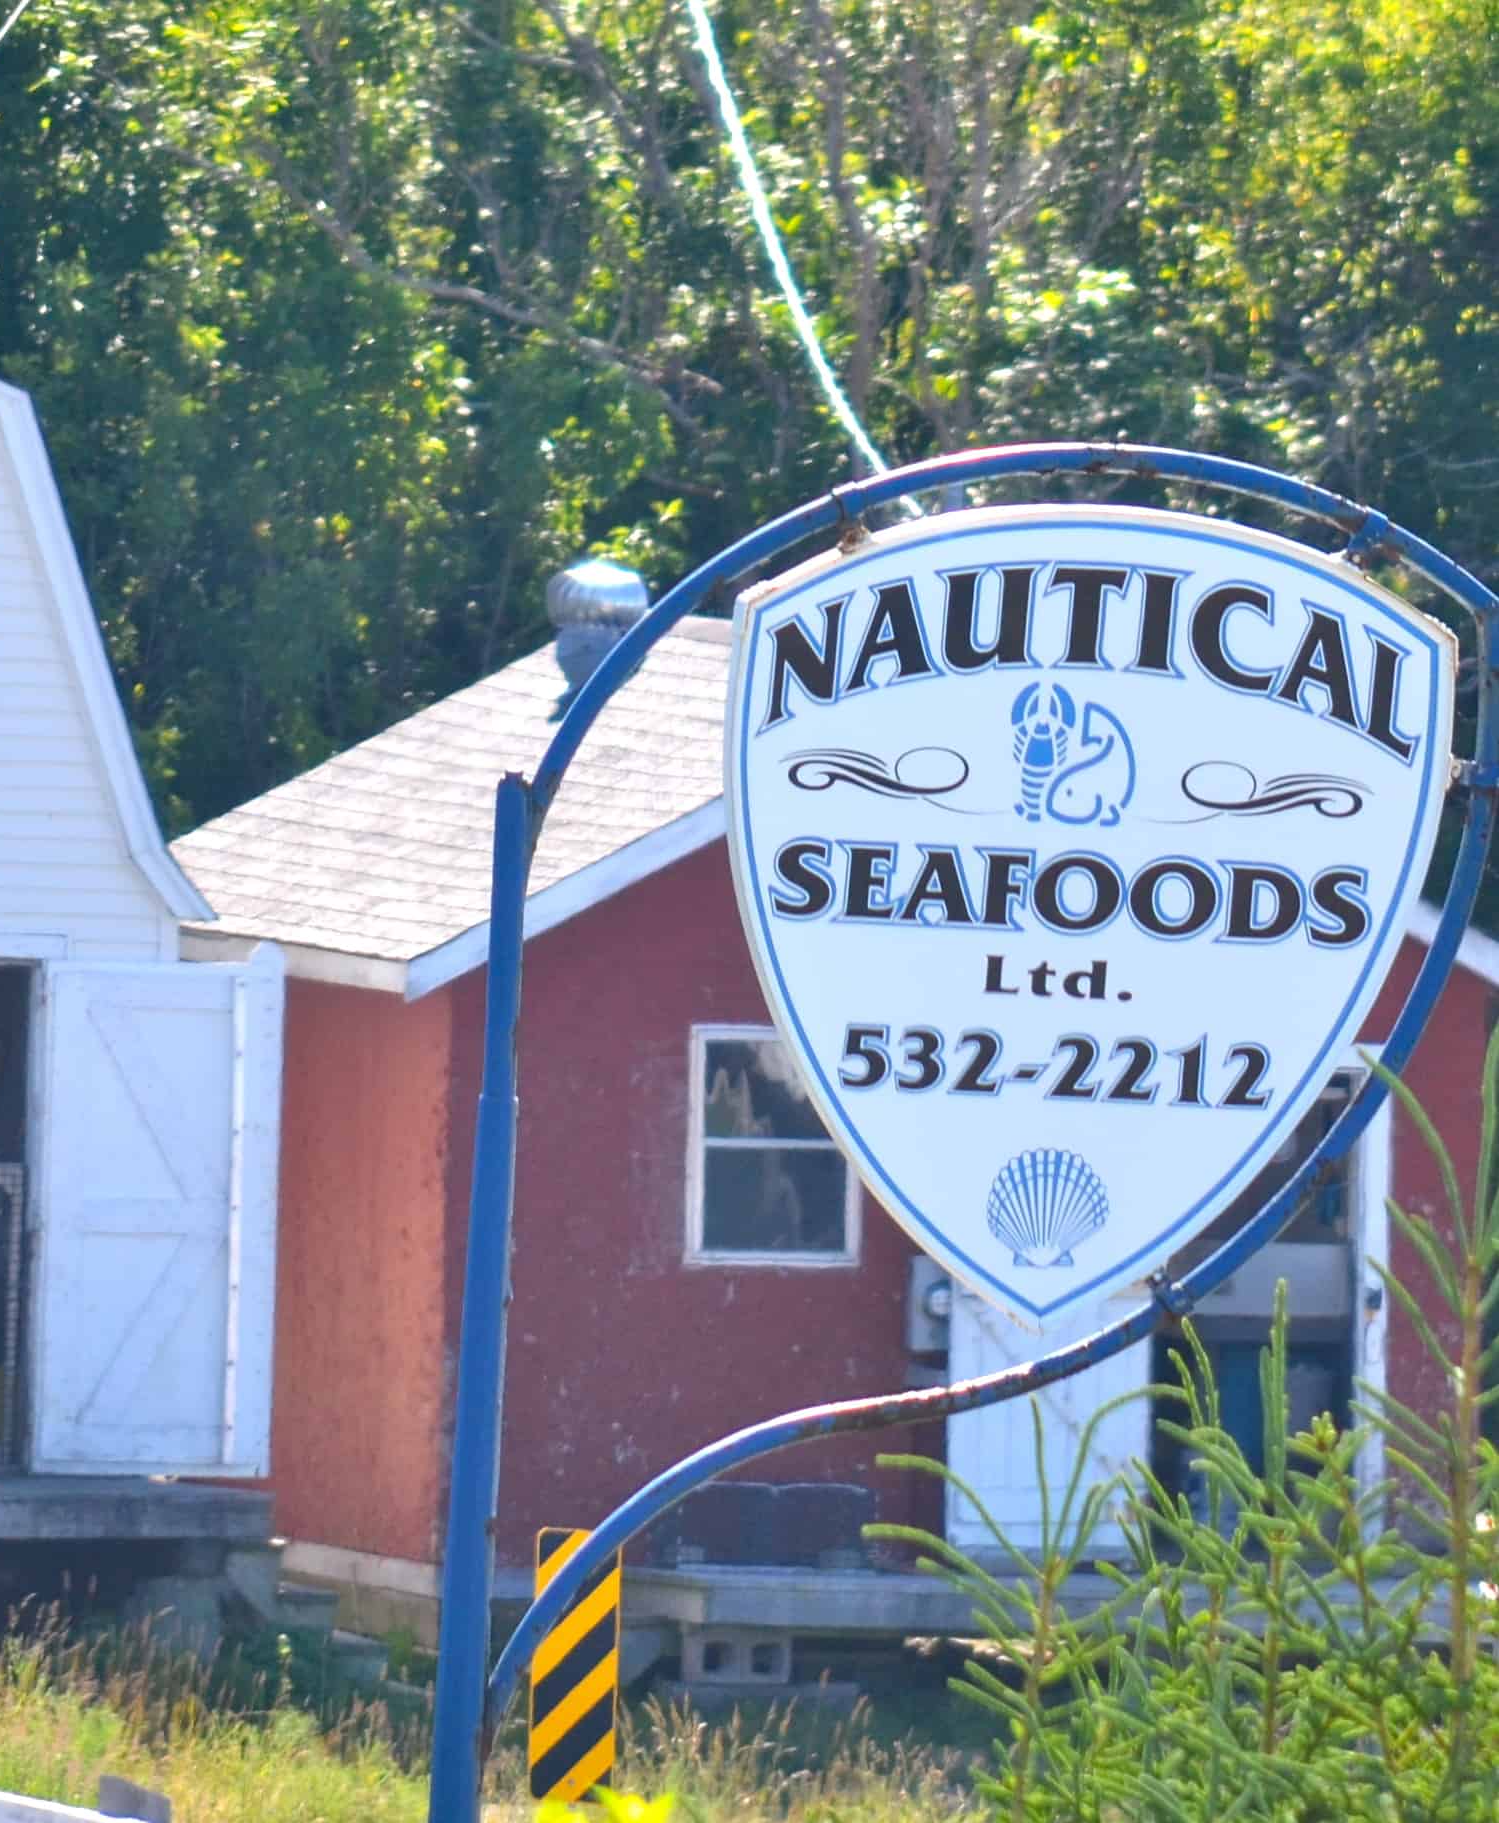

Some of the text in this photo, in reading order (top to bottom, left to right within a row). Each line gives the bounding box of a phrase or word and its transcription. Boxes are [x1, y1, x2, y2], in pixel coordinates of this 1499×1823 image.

[756, 561, 1421, 767] NAUTICAL
[770, 837, 1371, 948] SEAFOODS
[983, 955, 1133, 1002] Ltd.
[838, 1022, 1274, 1111] 532-2212
